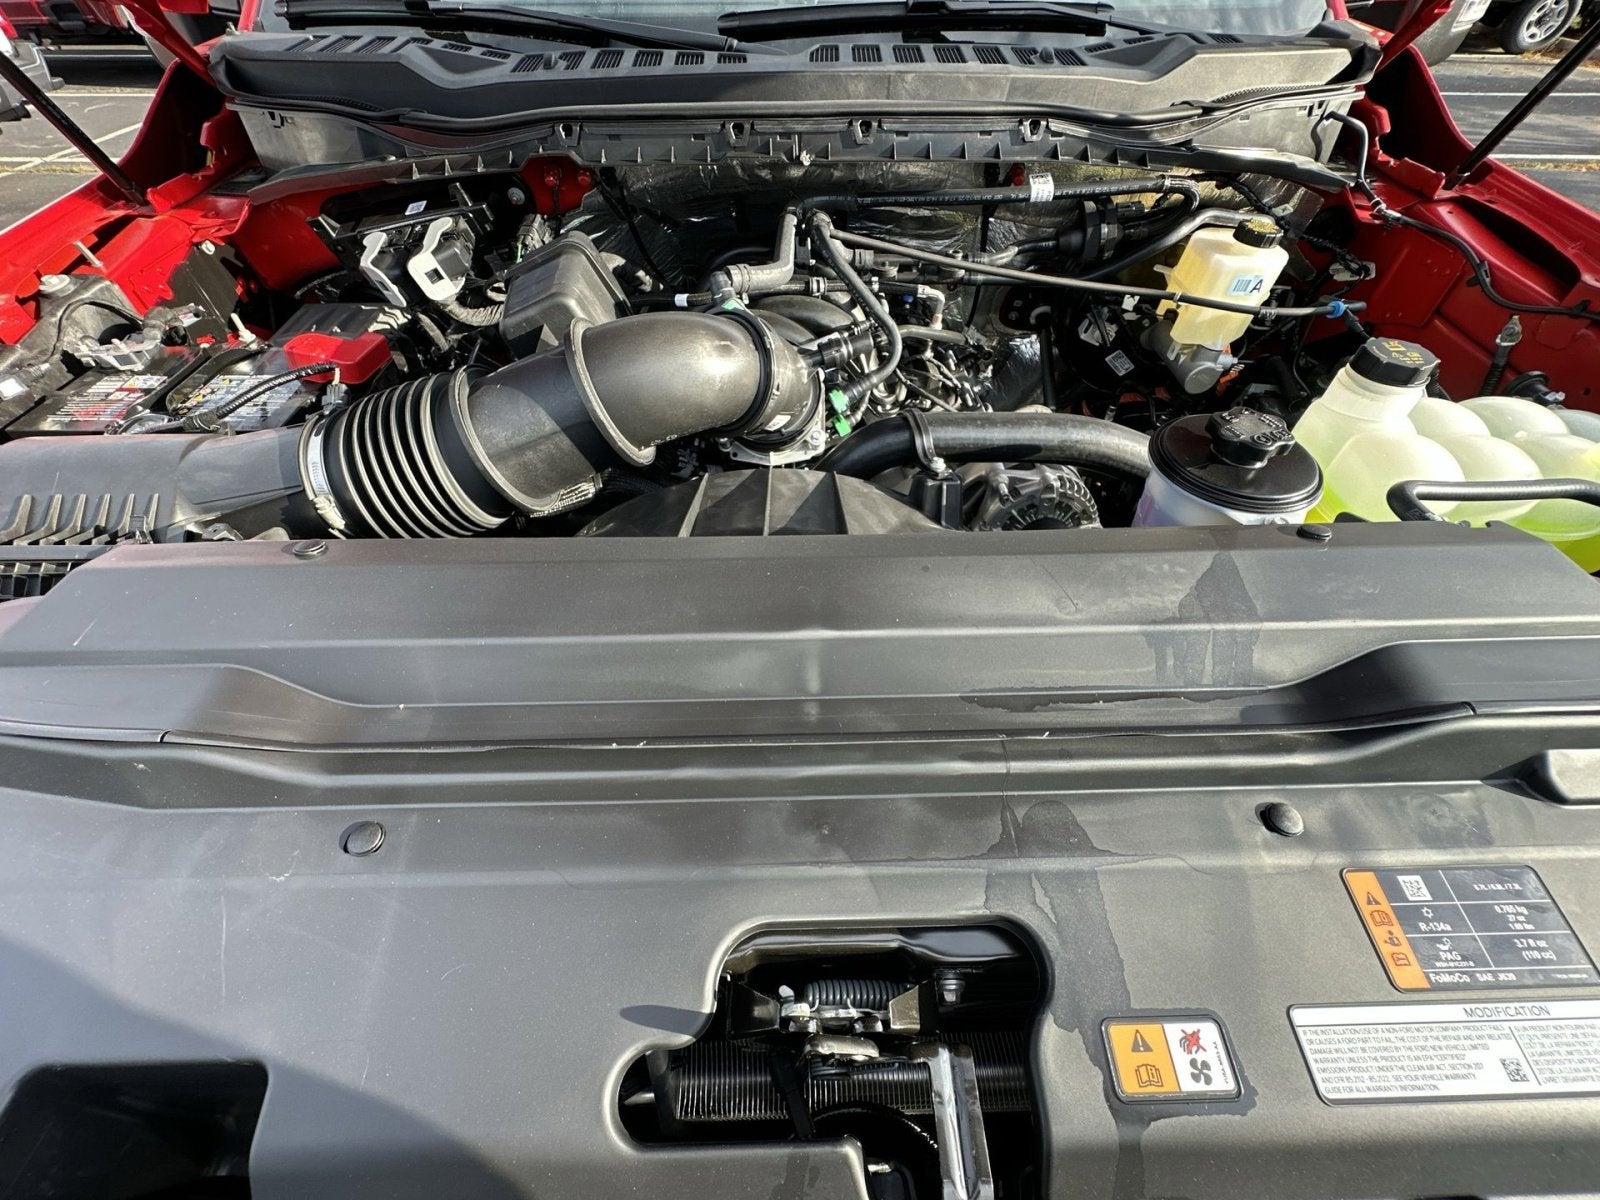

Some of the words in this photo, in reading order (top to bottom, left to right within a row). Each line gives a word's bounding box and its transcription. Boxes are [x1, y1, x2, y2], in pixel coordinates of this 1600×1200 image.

[1249, 278, 1264, 294] A
[1514, 904, 1529, 915] kg
[1417, 921, 1453, 932] R-134a
[1438, 951, 1462, 961] PAG
[1521, 950, 1542, 962] (110
[1540, 949, 1558, 961] cc)
[1429, 972, 1471, 984] FoMoCo
[1475, 972, 1497, 982] SAE
[1462, 1005, 1552, 1018] MODIFICATION
[1316, 1066, 1348, 1074] EMISSIONS
[1347, 1065, 1375, 1073] PRODUCT
[1442, 1072, 1477, 1080] WARRANTY
[1324, 1086, 1342, 1094] GUIDE
